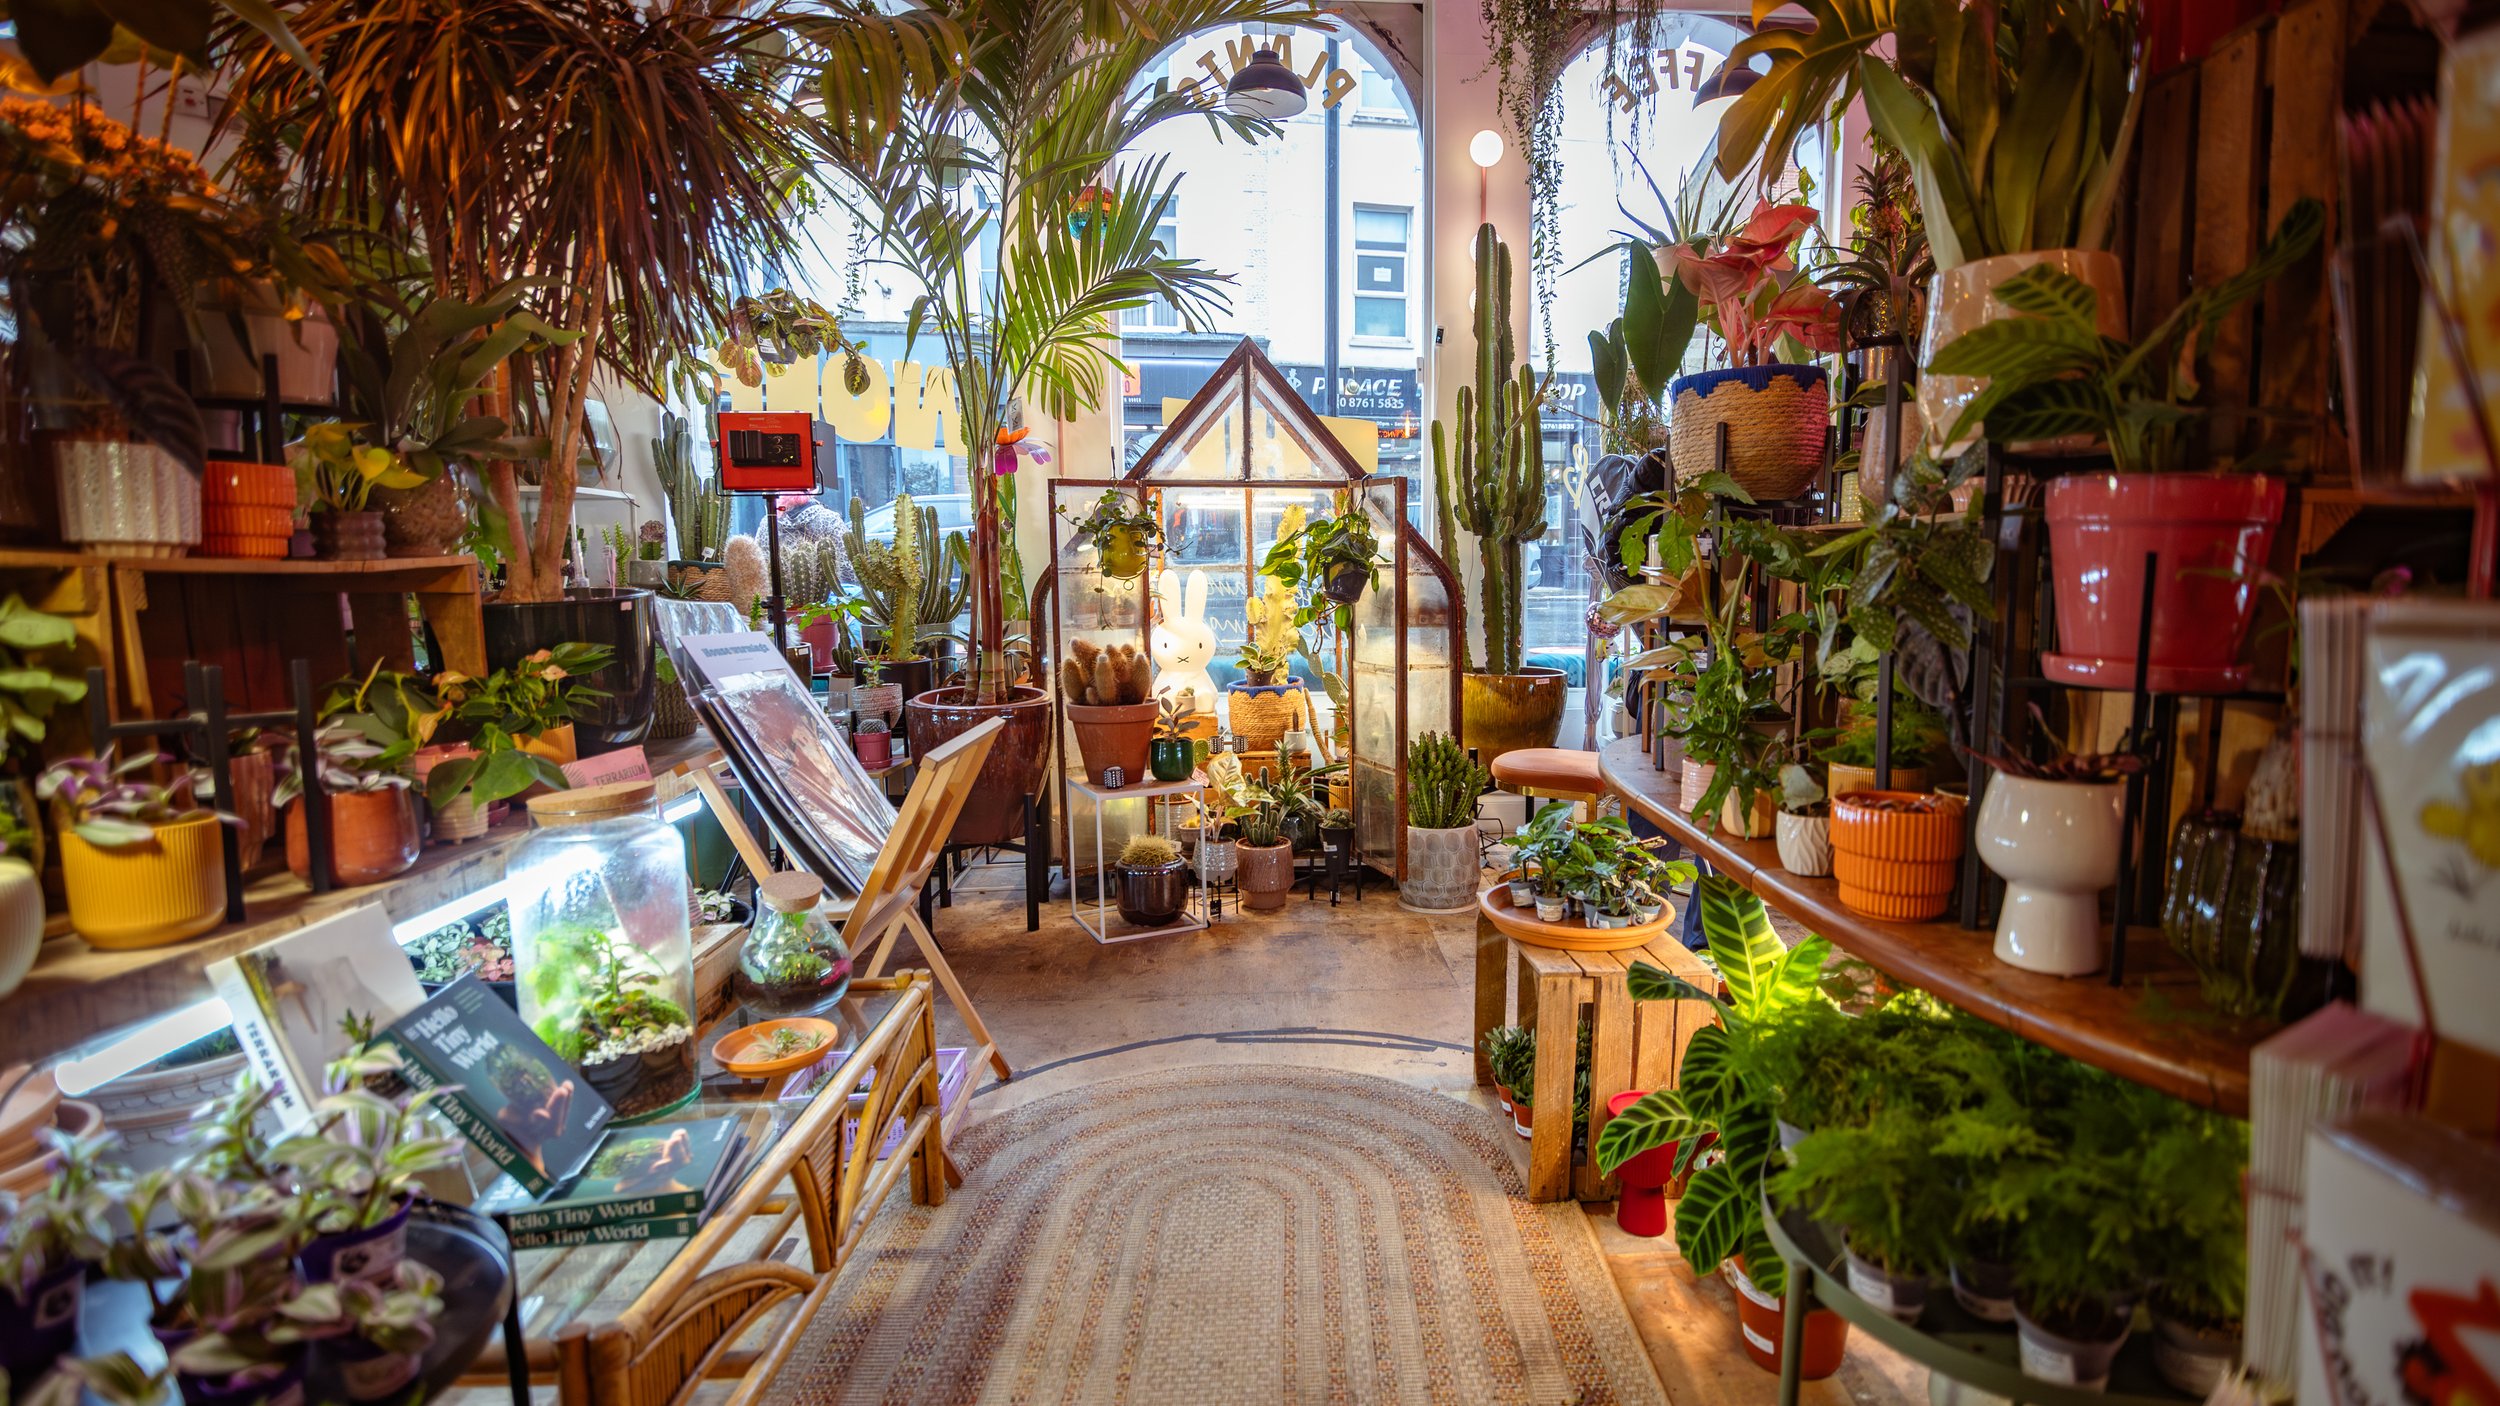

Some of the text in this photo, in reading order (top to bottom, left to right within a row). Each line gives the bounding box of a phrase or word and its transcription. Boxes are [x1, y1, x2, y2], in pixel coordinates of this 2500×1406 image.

[1311, 376, 1403, 396] PACE
[1349, 398, 1375, 408] 8761
[1378, 398, 1405, 409] 5835
[593, 763, 647, 787] TERRARIUM
[415, 1004, 459, 1040] Hello
[431, 1023, 473, 1056] Tiny
[450, 1028, 500, 1071] World
[245, 1020, 296, 1110] TERRARM
[436, 1093, 473, 1125] Tiny
[469, 1120, 517, 1166] World
[553, 1206, 597, 1225] Tiny
[597, 1198, 656, 1220] World
[512, 1222, 650, 1248] ello Tiny World
